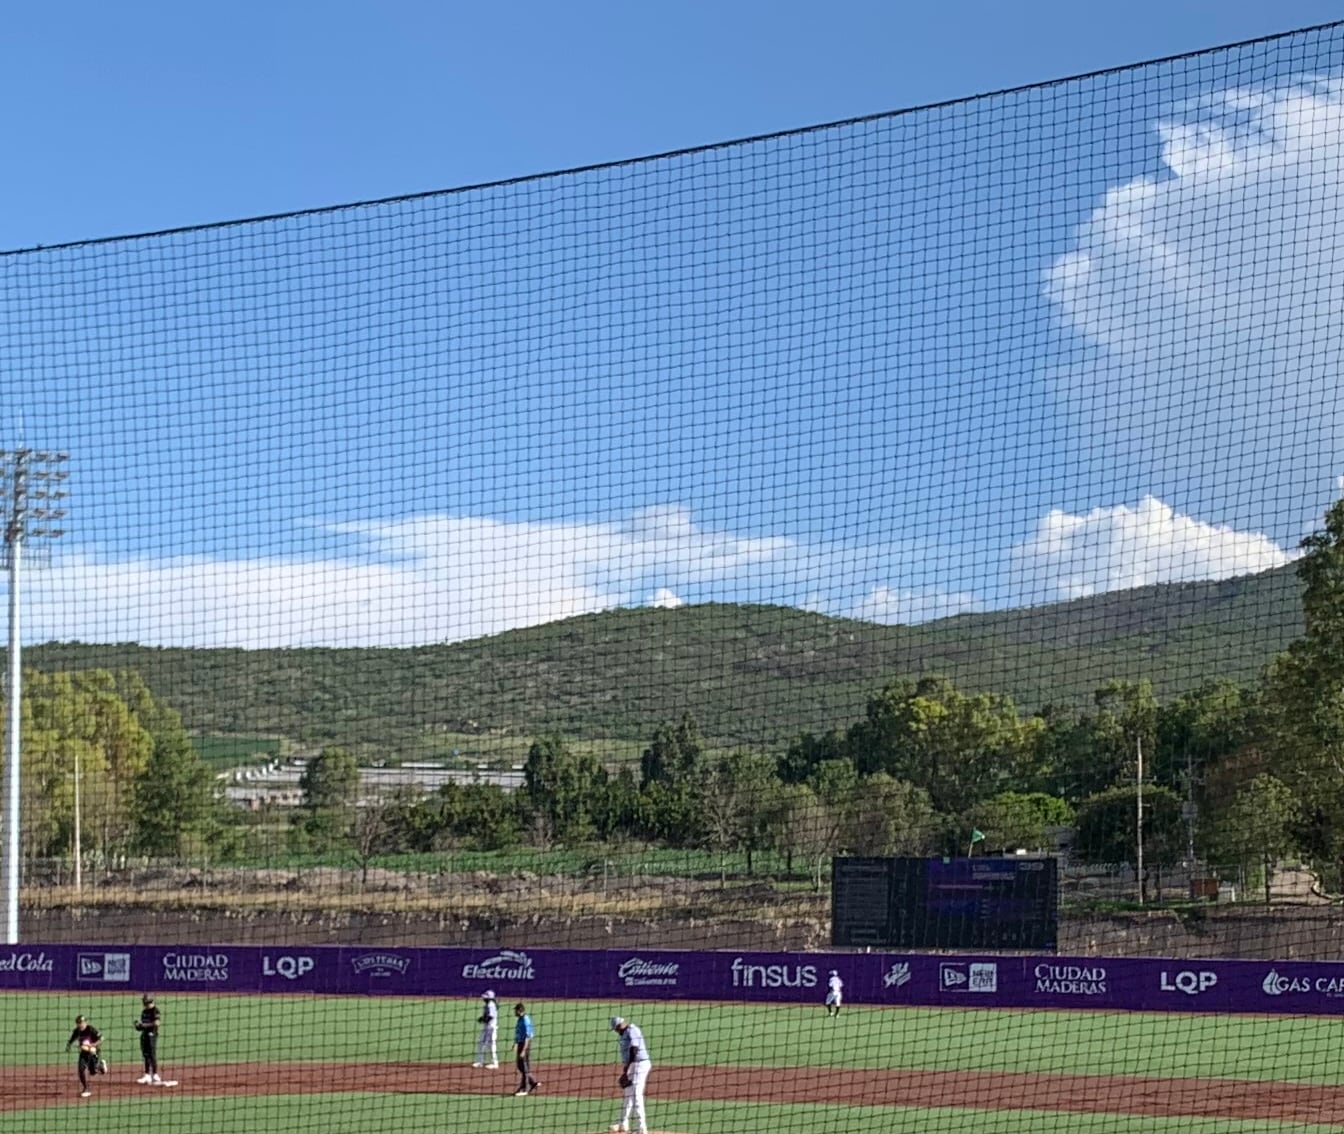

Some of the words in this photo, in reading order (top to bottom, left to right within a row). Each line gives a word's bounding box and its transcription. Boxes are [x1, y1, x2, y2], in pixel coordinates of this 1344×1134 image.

[163, 953, 229, 968] CIUDAD
[263, 956, 314, 979] LQP
[164, 967, 229, 981] MADERAS
[462, 963, 535, 980] Electrolit
[731, 957, 817, 987] finsus
[1034, 964, 1106, 981] CIUDAD
[1034, 980, 1106, 994] MADERAS
[1160, 971, 1218, 994] LQP
[1276, 976, 1311, 993] GAS
